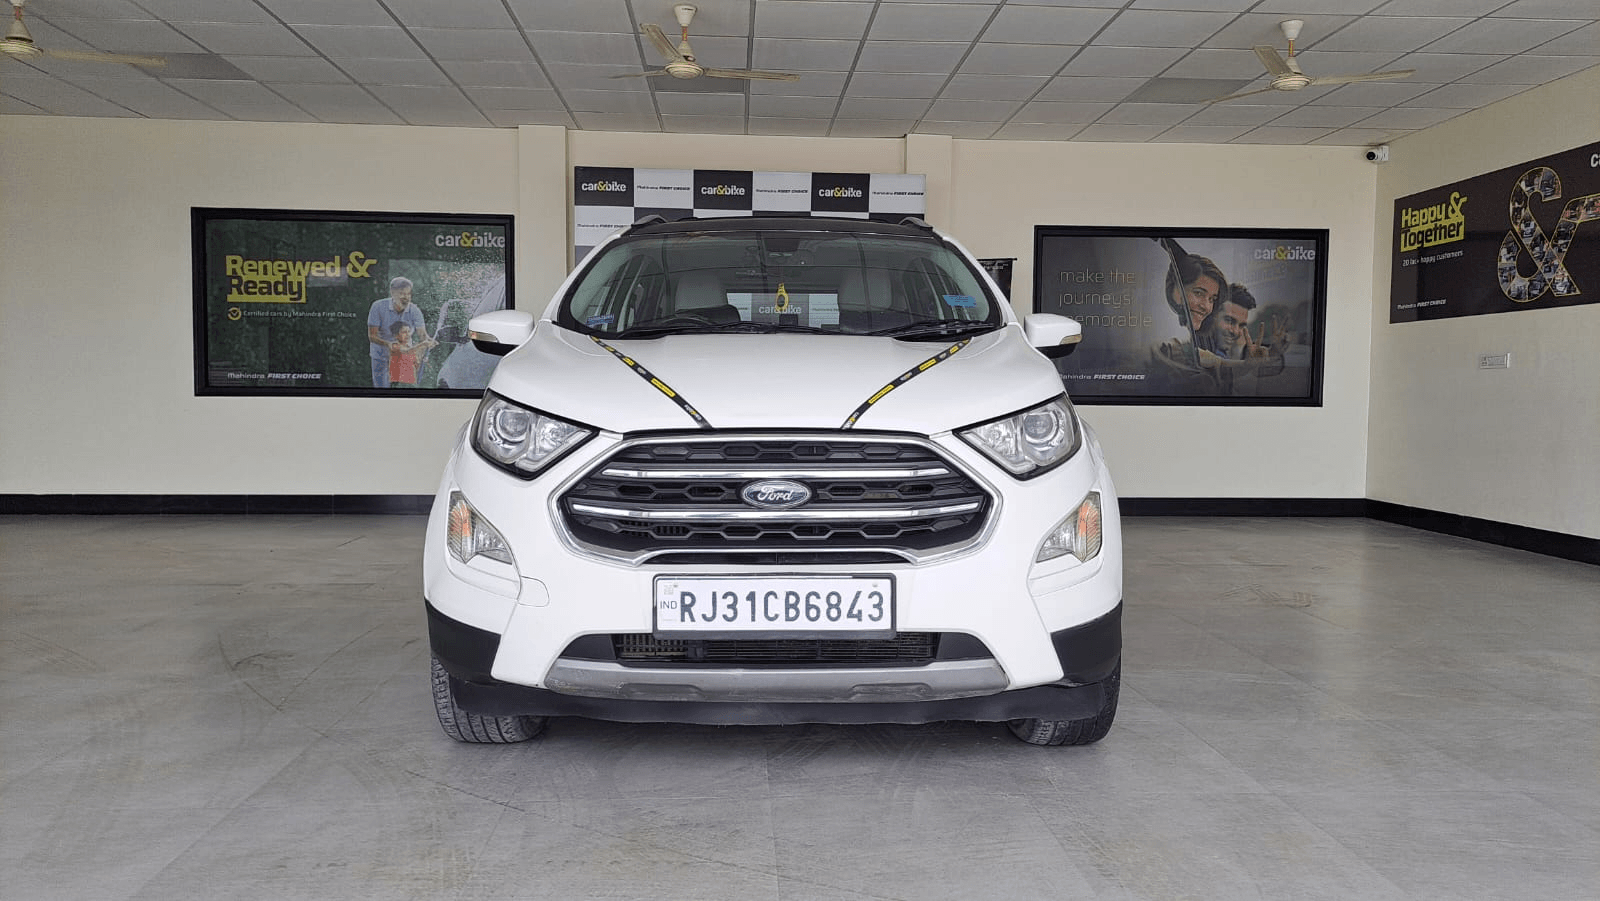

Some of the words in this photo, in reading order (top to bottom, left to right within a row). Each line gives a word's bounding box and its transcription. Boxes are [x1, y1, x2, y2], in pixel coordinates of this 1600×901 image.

[581, 180, 627, 192] car&bike
[701, 185, 745, 196] car&bike
[818, 187, 863, 198] car&bike
[1402, 203, 1446, 228] Happy
[1448, 191, 1468, 220] &
[435, 231, 506, 248] car&bike
[1401, 221, 1463, 249] Together
[1254, 246, 1316, 261] car&bike
[225, 255, 341, 277] Renewed
[346, 251, 377, 278] &
[1060, 268, 1105, 283] make
[1110, 267, 1137, 284] the
[230, 274, 304, 301] Ready
[1059, 292, 1132, 309] journeys
[1067, 312, 1153, 327] emorable
[757, 485, 793, 501] Ford
[660, 600, 678, 610] IND
[680, 590, 884, 623] RJ31CB6843
